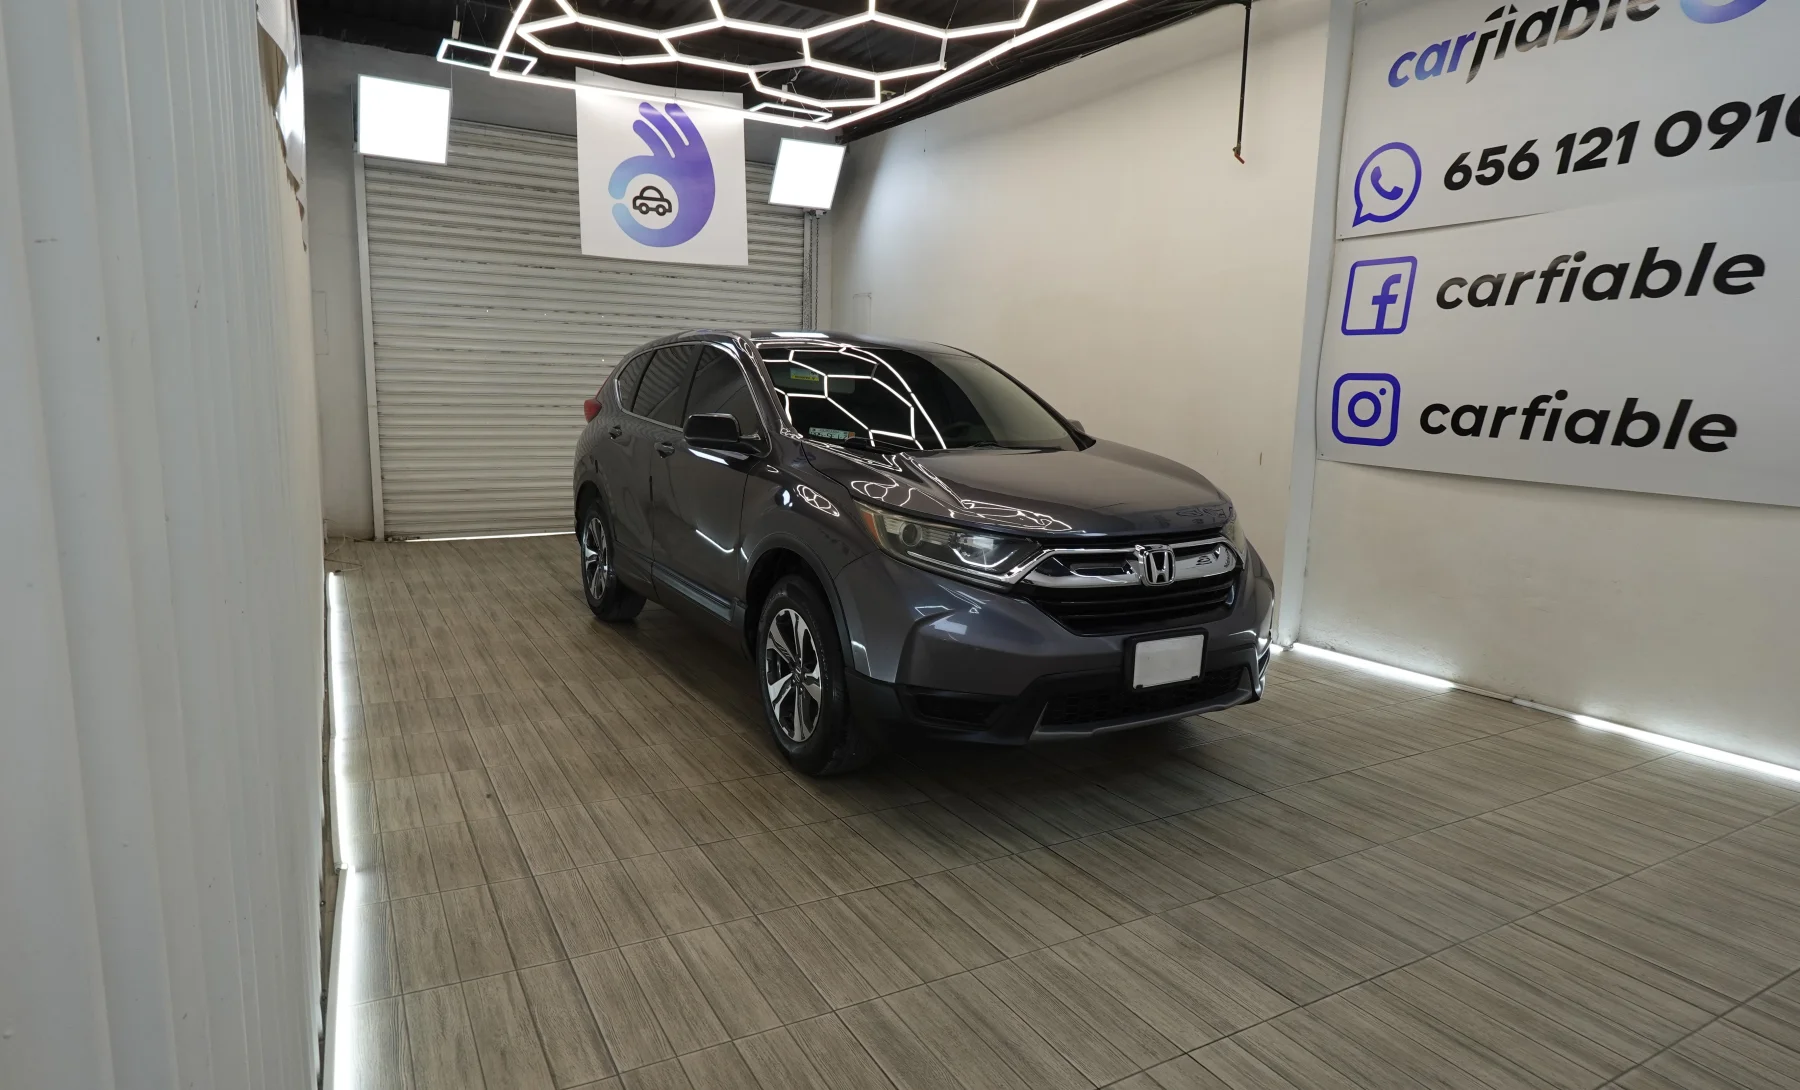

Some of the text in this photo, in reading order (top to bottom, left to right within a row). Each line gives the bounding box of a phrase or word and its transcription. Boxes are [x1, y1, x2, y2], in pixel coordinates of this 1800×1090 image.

[1443, 138, 1540, 191] 656
[1555, 120, 1641, 175] 121
[1435, 241, 1766, 310] carfiable
[1419, 389, 1738, 453] carfiable
